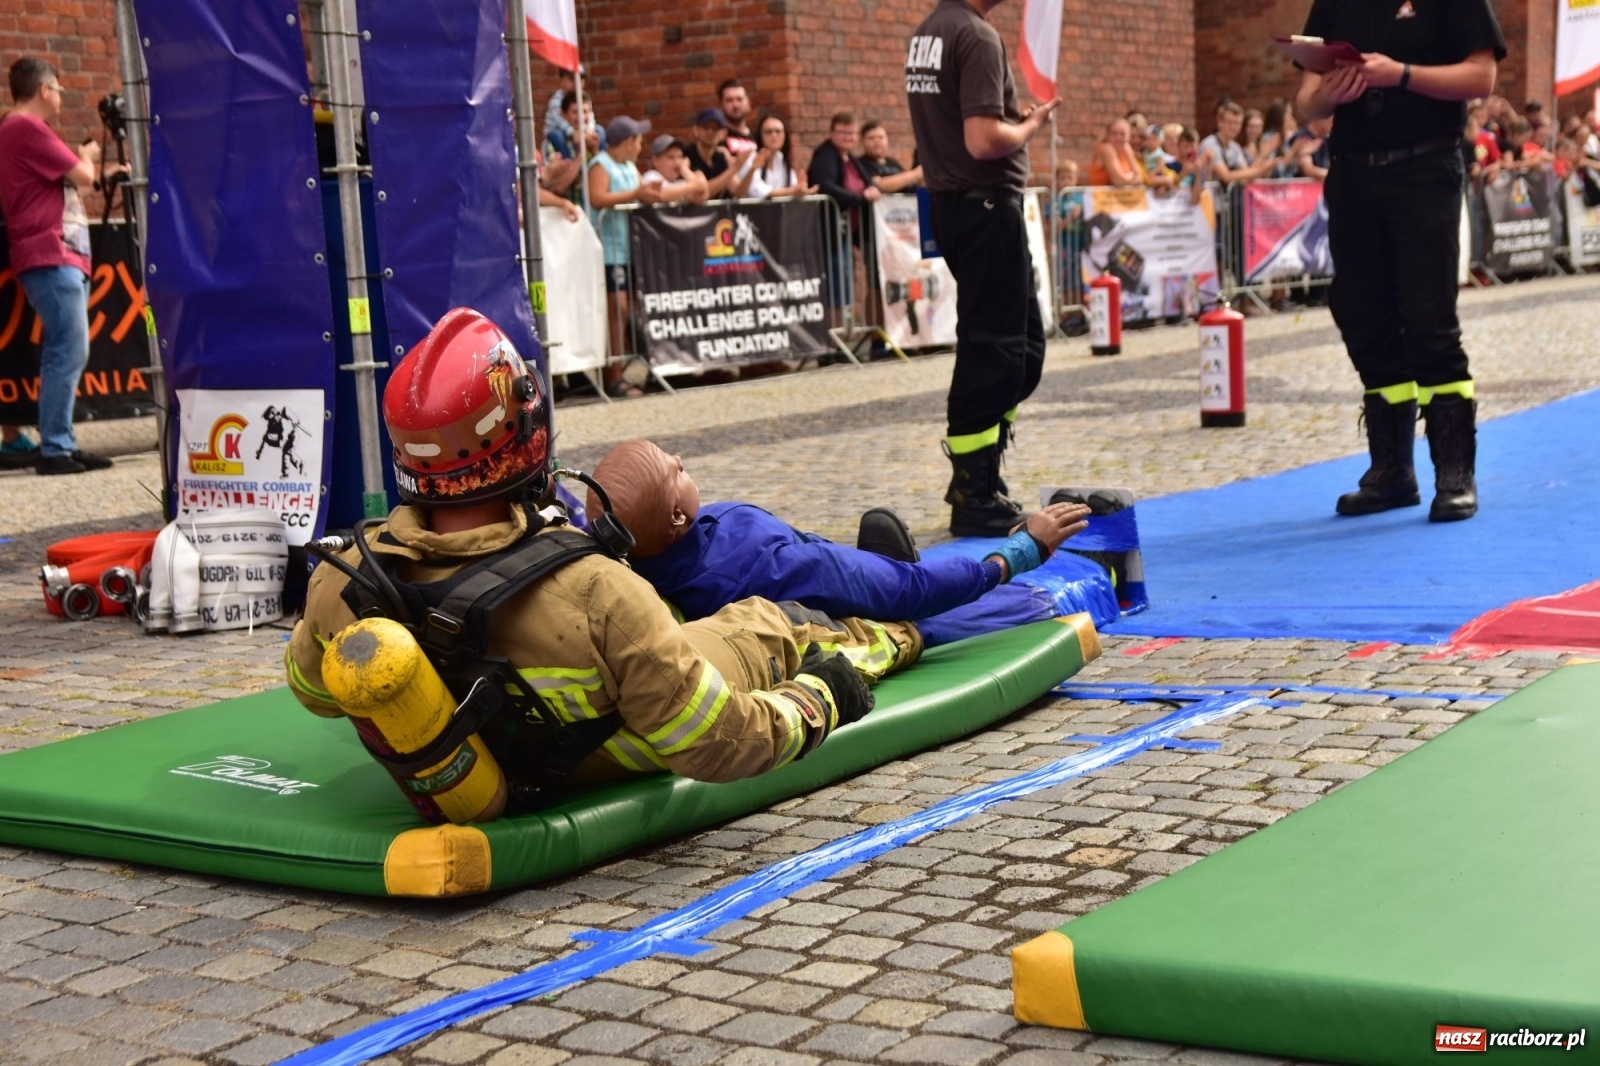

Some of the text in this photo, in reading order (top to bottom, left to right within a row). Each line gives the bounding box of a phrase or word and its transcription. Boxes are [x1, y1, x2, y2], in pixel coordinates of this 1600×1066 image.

[644, 278, 821, 314] FIREFIGHTER COMBAT
[650, 303, 824, 340] CHALLENGE POLAND
[697, 331, 790, 360] FUNDATION
[195, 462, 226, 472] KALISZ
[182, 489, 315, 511] CHALLENGE
[183, 479, 313, 493] FIREFIGHTER COMBAT
[411, 750, 473, 792] MSA
